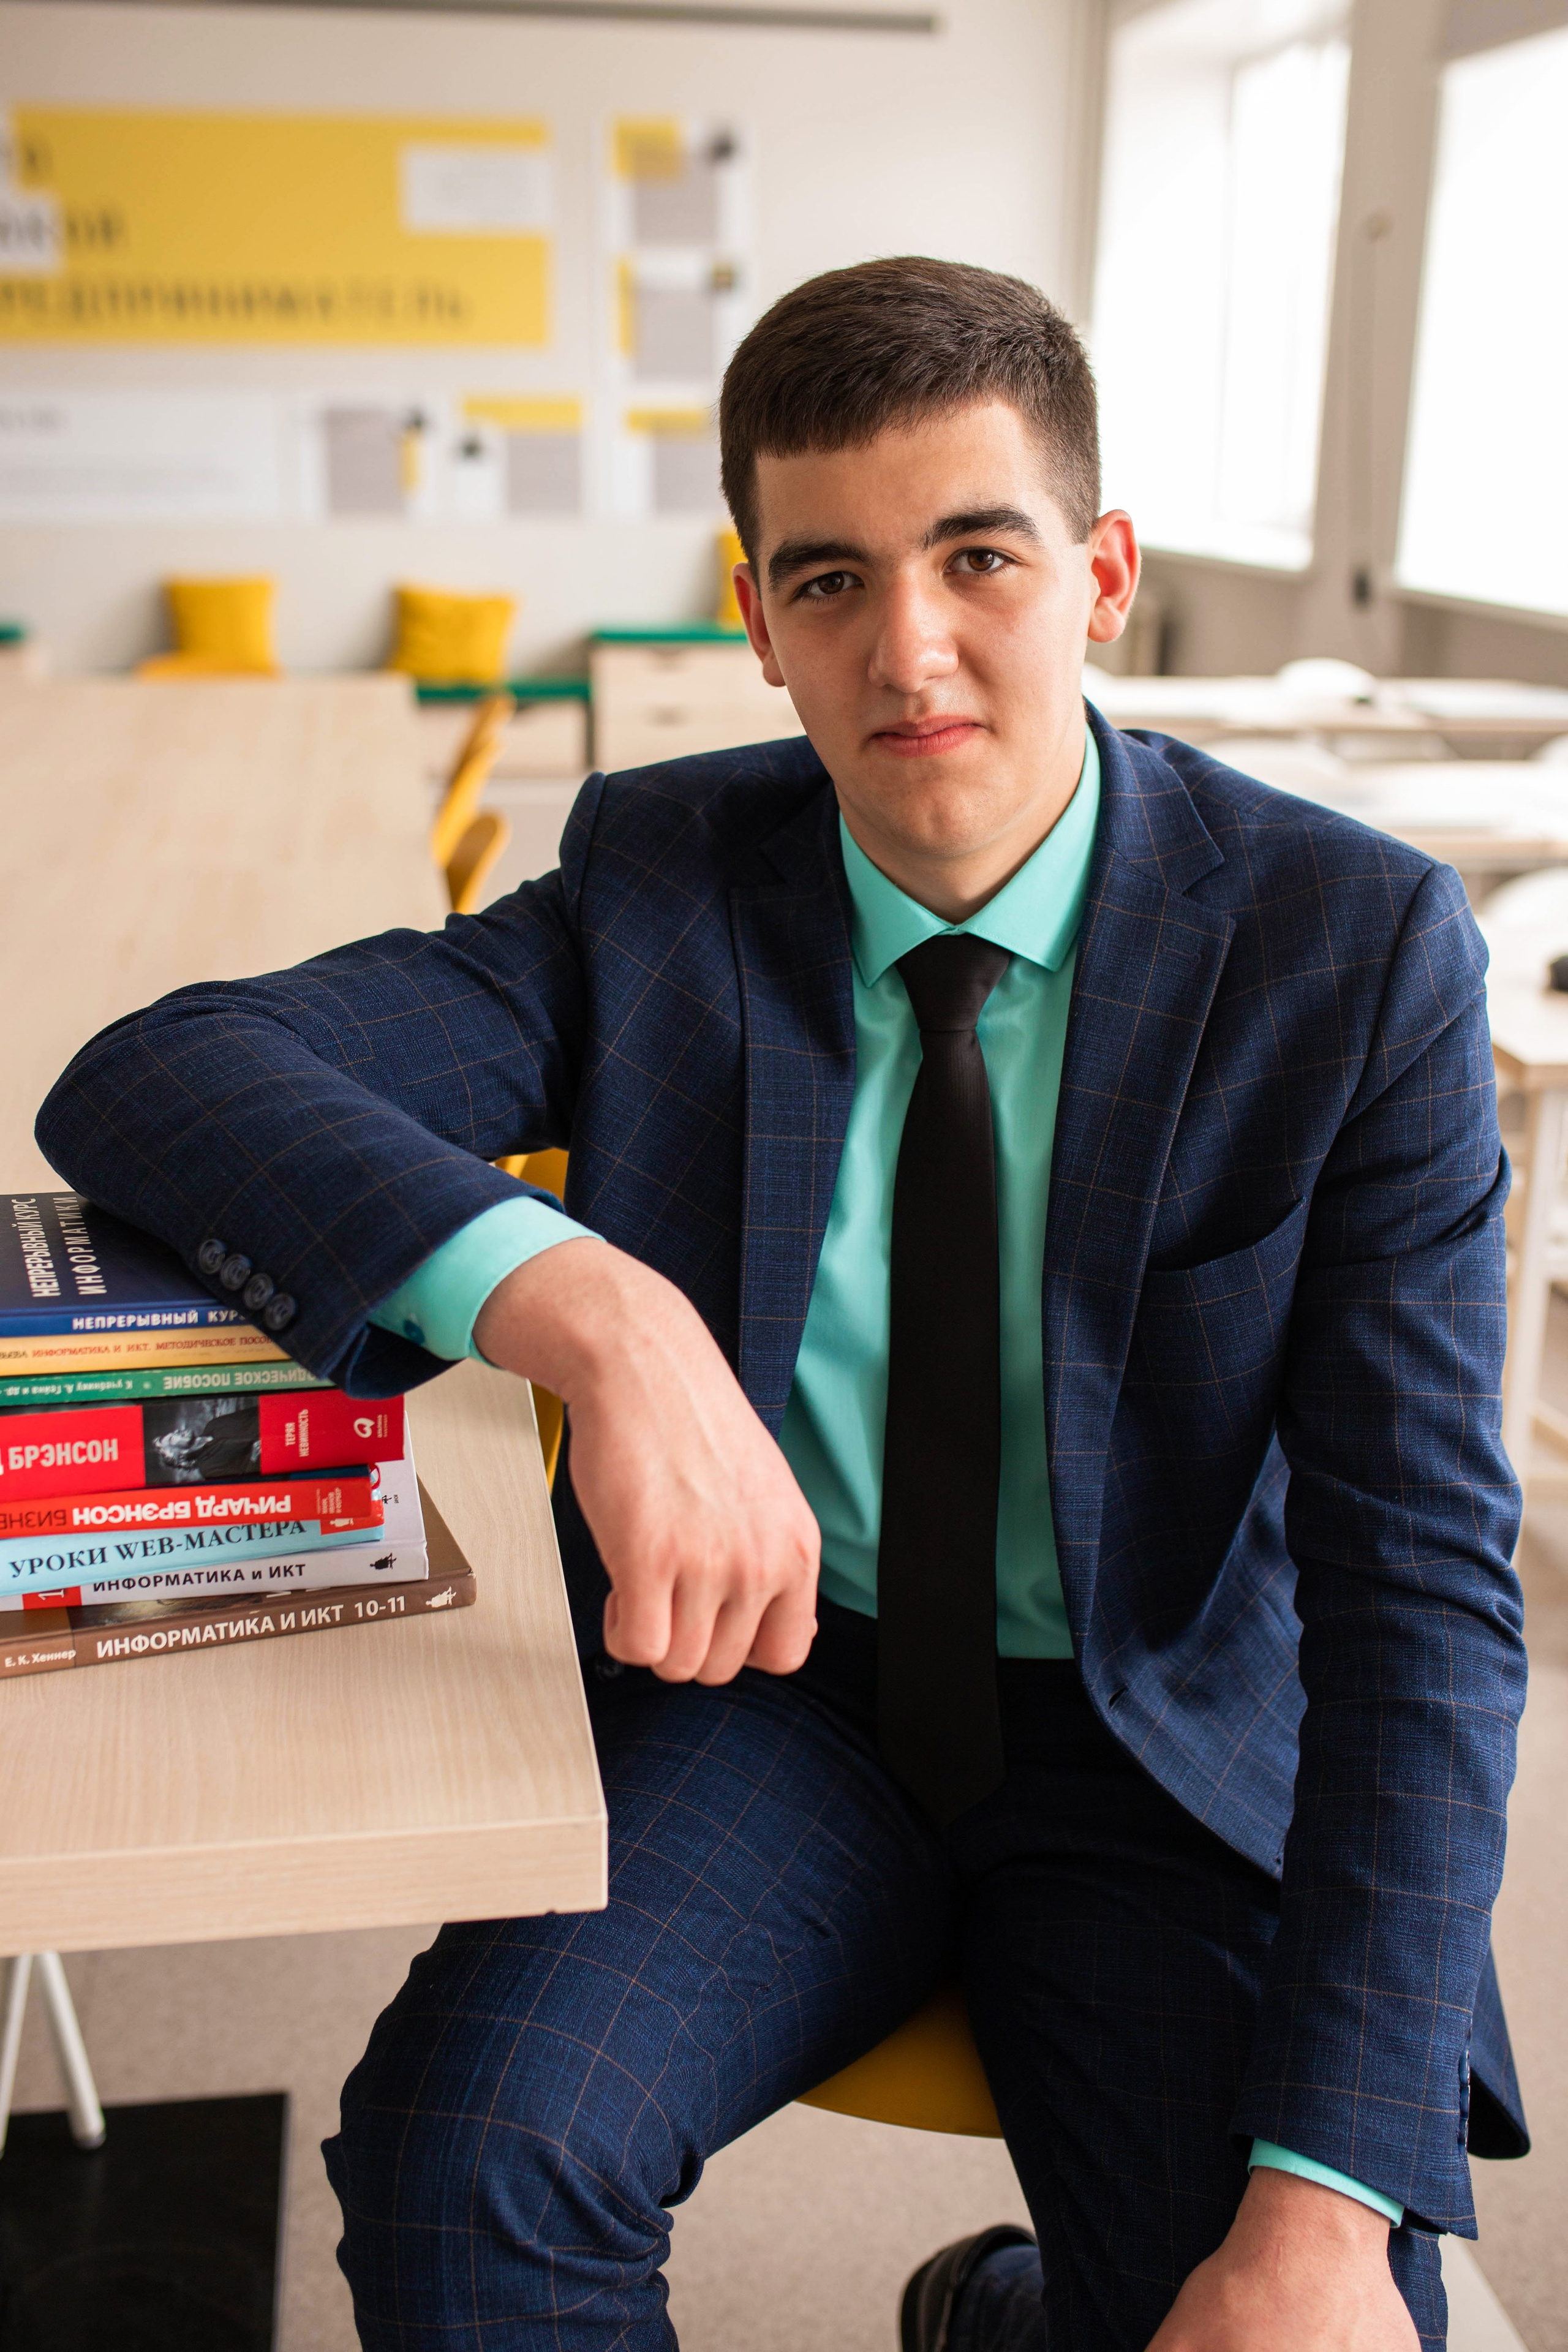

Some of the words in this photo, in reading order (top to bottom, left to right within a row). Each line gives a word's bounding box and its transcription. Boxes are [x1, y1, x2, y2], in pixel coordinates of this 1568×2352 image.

[11, 1197, 41, 1220] КУРС
[53, 1197, 108, 1295] ИНФОРМАТИКИ
[12, 1221, 61, 1297] НЕПРЕРЫВНЫЙ
[72, 1310, 198, 1330] НЕПРЕРЫВНЫЙ
[32, 1345, 110, 1358] ИНФОРМАТИКА
[156, 1337, 236, 1351] МЕТОДИЧЕСКОЕ
[76, 1379, 123, 1392] учебнику
[125, 1380, 133, 1390] К
[163, 1372, 231, 1390] ПОСОБИЕ
[285, 1422, 296, 1447] ТЕРЯ
[298, 1408, 309, 1458] НЕВИННОСТЬ
[8, 1438, 119, 1471] БРЭНСОН
[72, 1501, 191, 1526] БРЭНСОН
[195, 1494, 292, 1518] РИЧАРД
[9, 1547, 109, 1579] УРОКИ
[114, 1520, 307, 1561] WEB-МАСТЕРА
[93, 1568, 245, 1593] ИНФОРМАТИКА
[252, 1570, 263, 1580] и
[269, 1563, 306, 1578] ИКТ
[97, 1616, 276, 1659] ИНФОРМАТИКА
[281, 1611, 296, 1630] И
[301, 1604, 344, 1627] ИКТ
[355, 1595, 406, 1619] 10-11
[5, 1657, 16, 1667] Е.
[18, 1655, 30, 1665] К.
[32, 1649, 77, 1664] Хеннер
